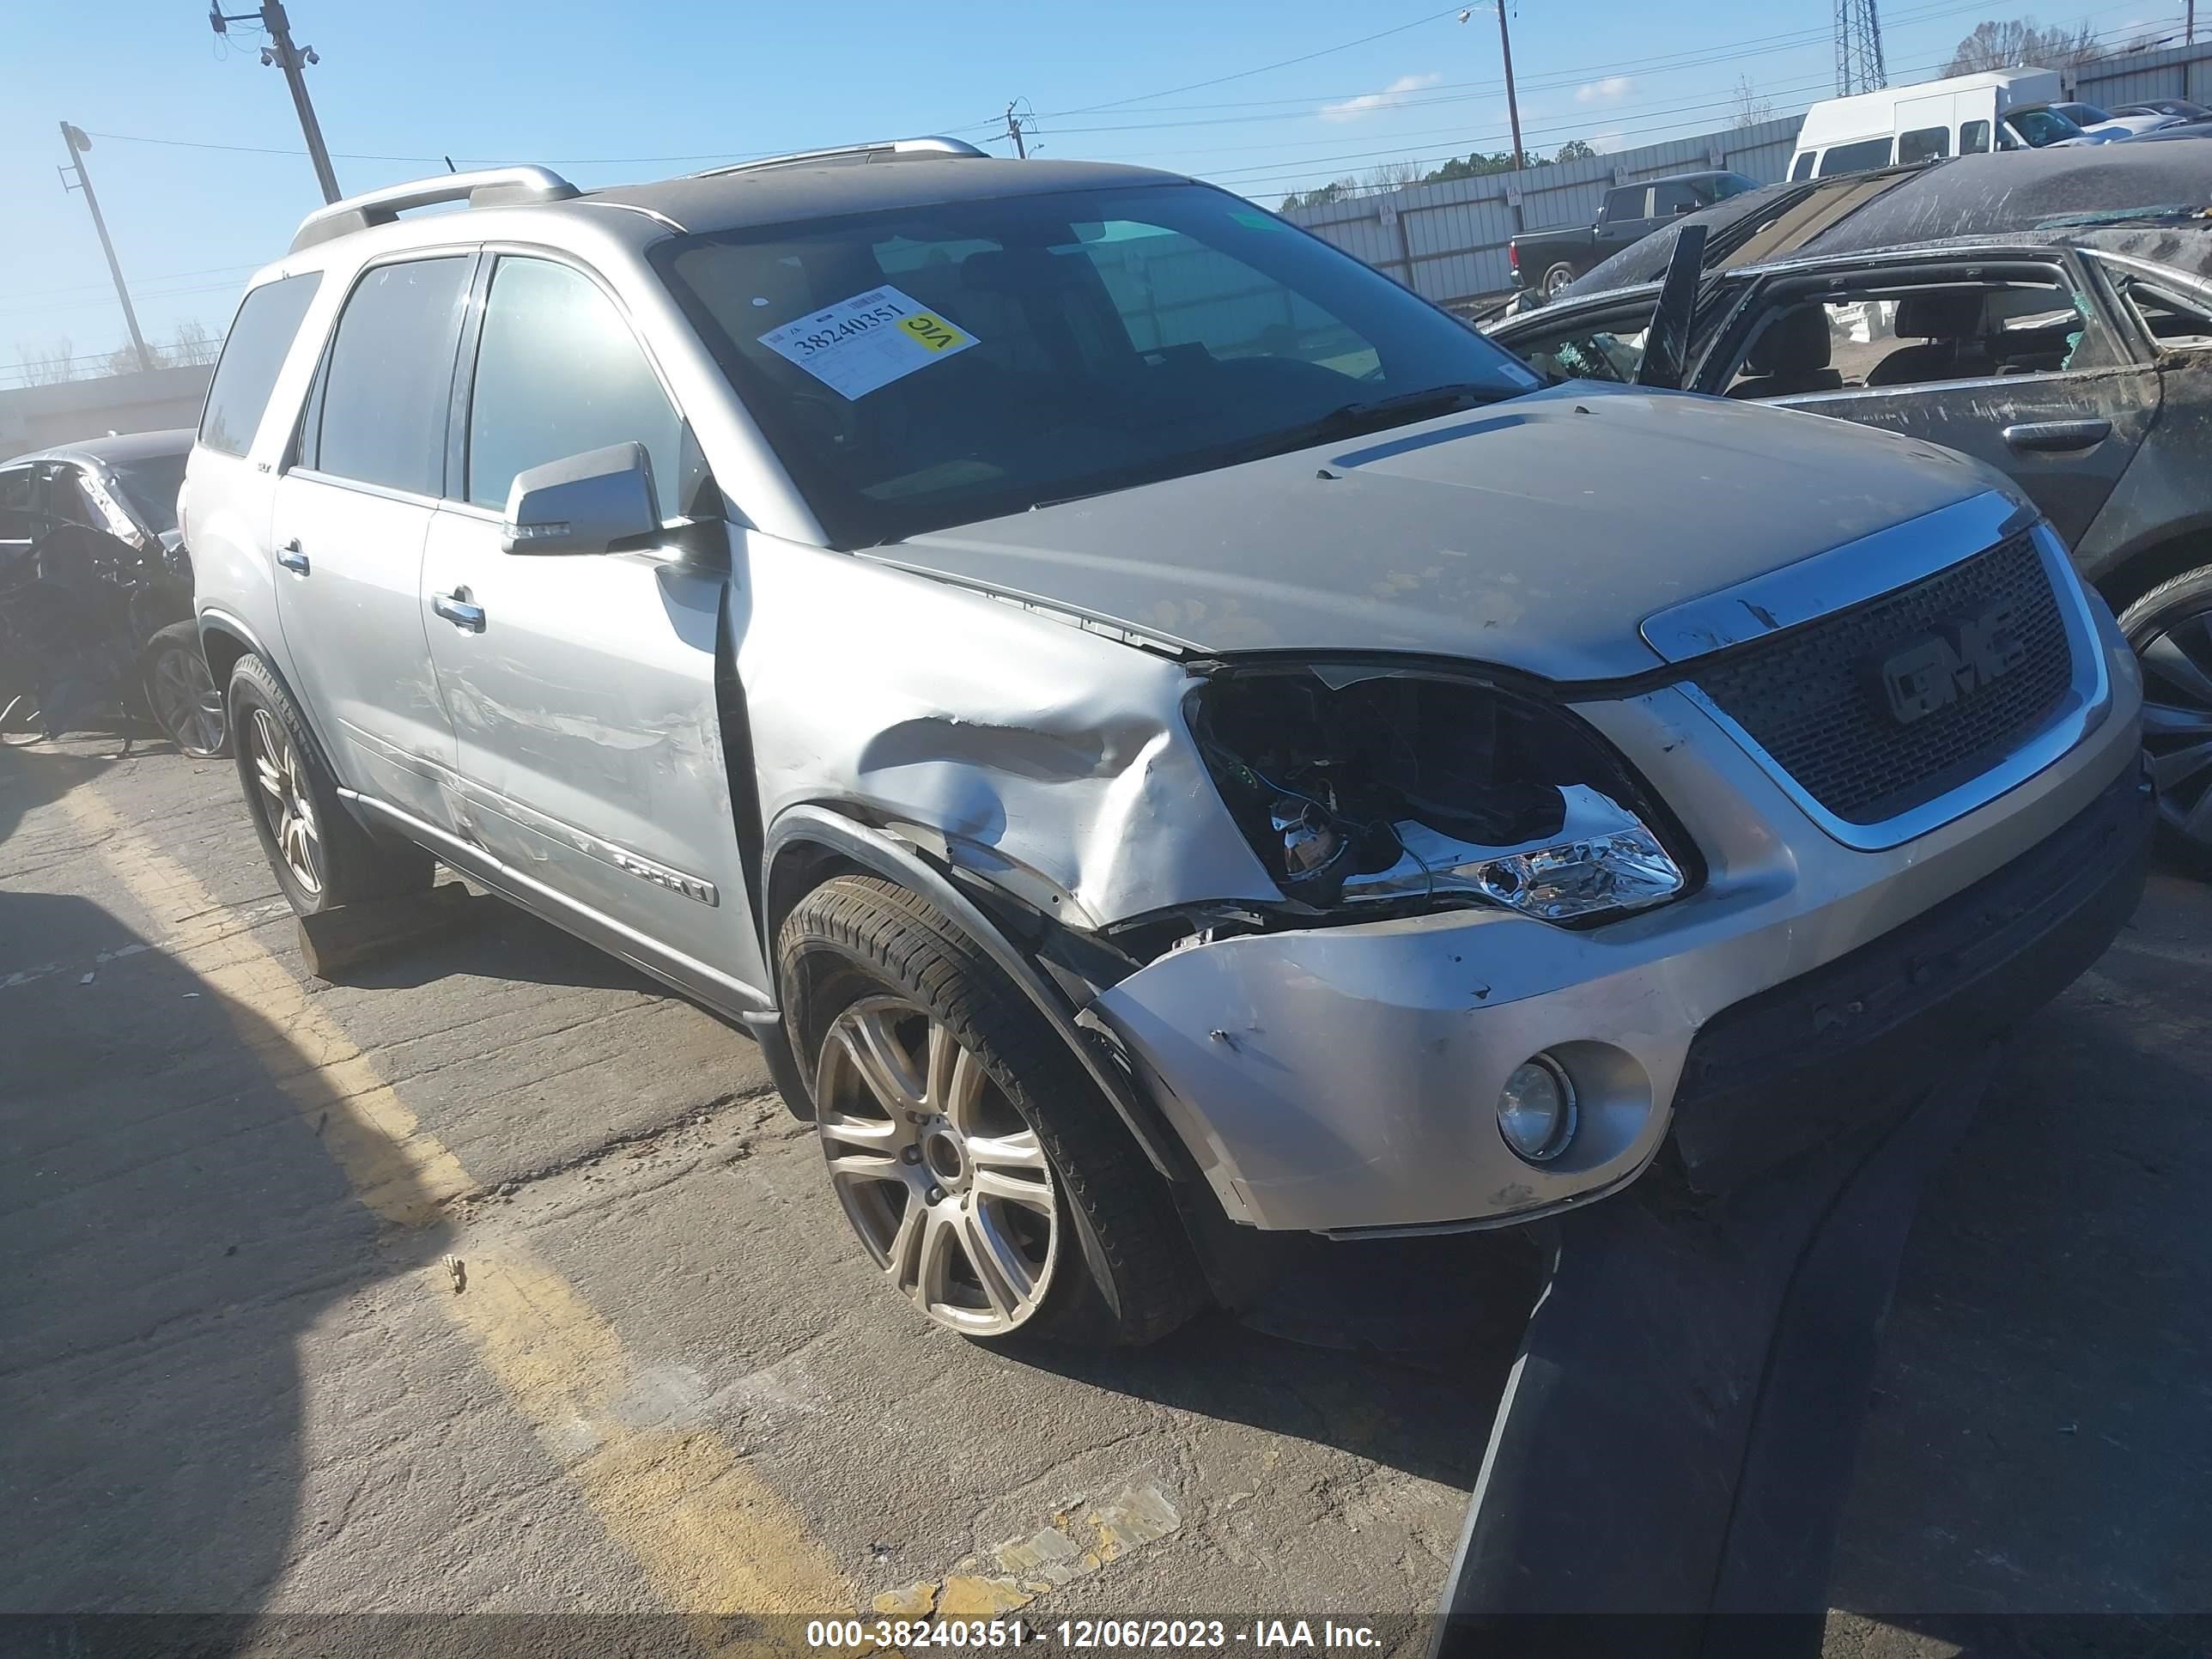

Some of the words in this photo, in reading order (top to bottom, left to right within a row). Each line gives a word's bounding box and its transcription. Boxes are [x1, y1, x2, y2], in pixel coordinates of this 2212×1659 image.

[793, 303, 906, 356] 38240351
[908, 318, 953, 349] VIC
[1881, 604, 2023, 724] GMC
[613, 854, 709, 902] ACADIA
